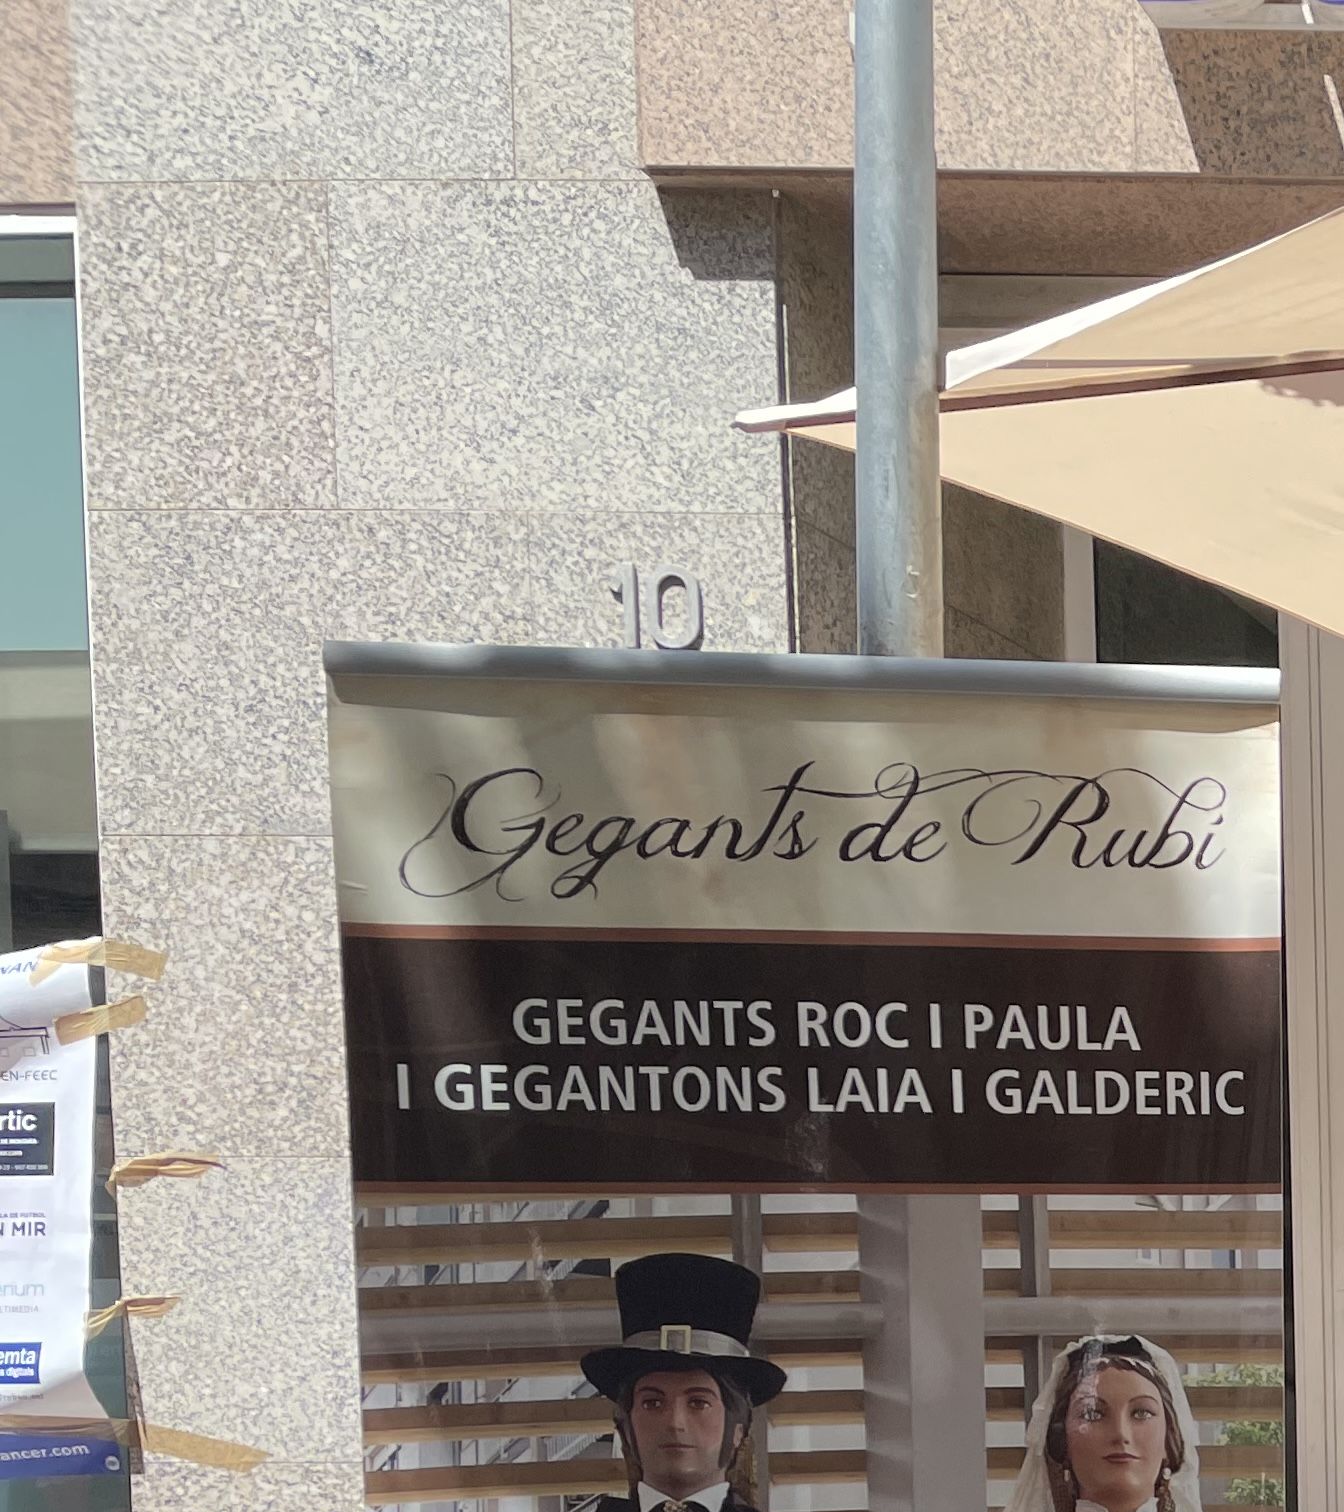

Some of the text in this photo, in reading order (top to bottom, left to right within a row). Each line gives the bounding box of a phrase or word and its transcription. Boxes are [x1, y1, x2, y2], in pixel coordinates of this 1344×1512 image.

[606, 560, 704, 651] 10
[397, 760, 818, 903] Gegants
[839, 762, 946, 864] de
[512, 998, 1142, 1052] GEGANTS ROC I PAULA
[396, 1063, 1246, 1117] I GEGANTONS LAIA I GALDERIC
[12, 1221, 46, 1236] MIR
